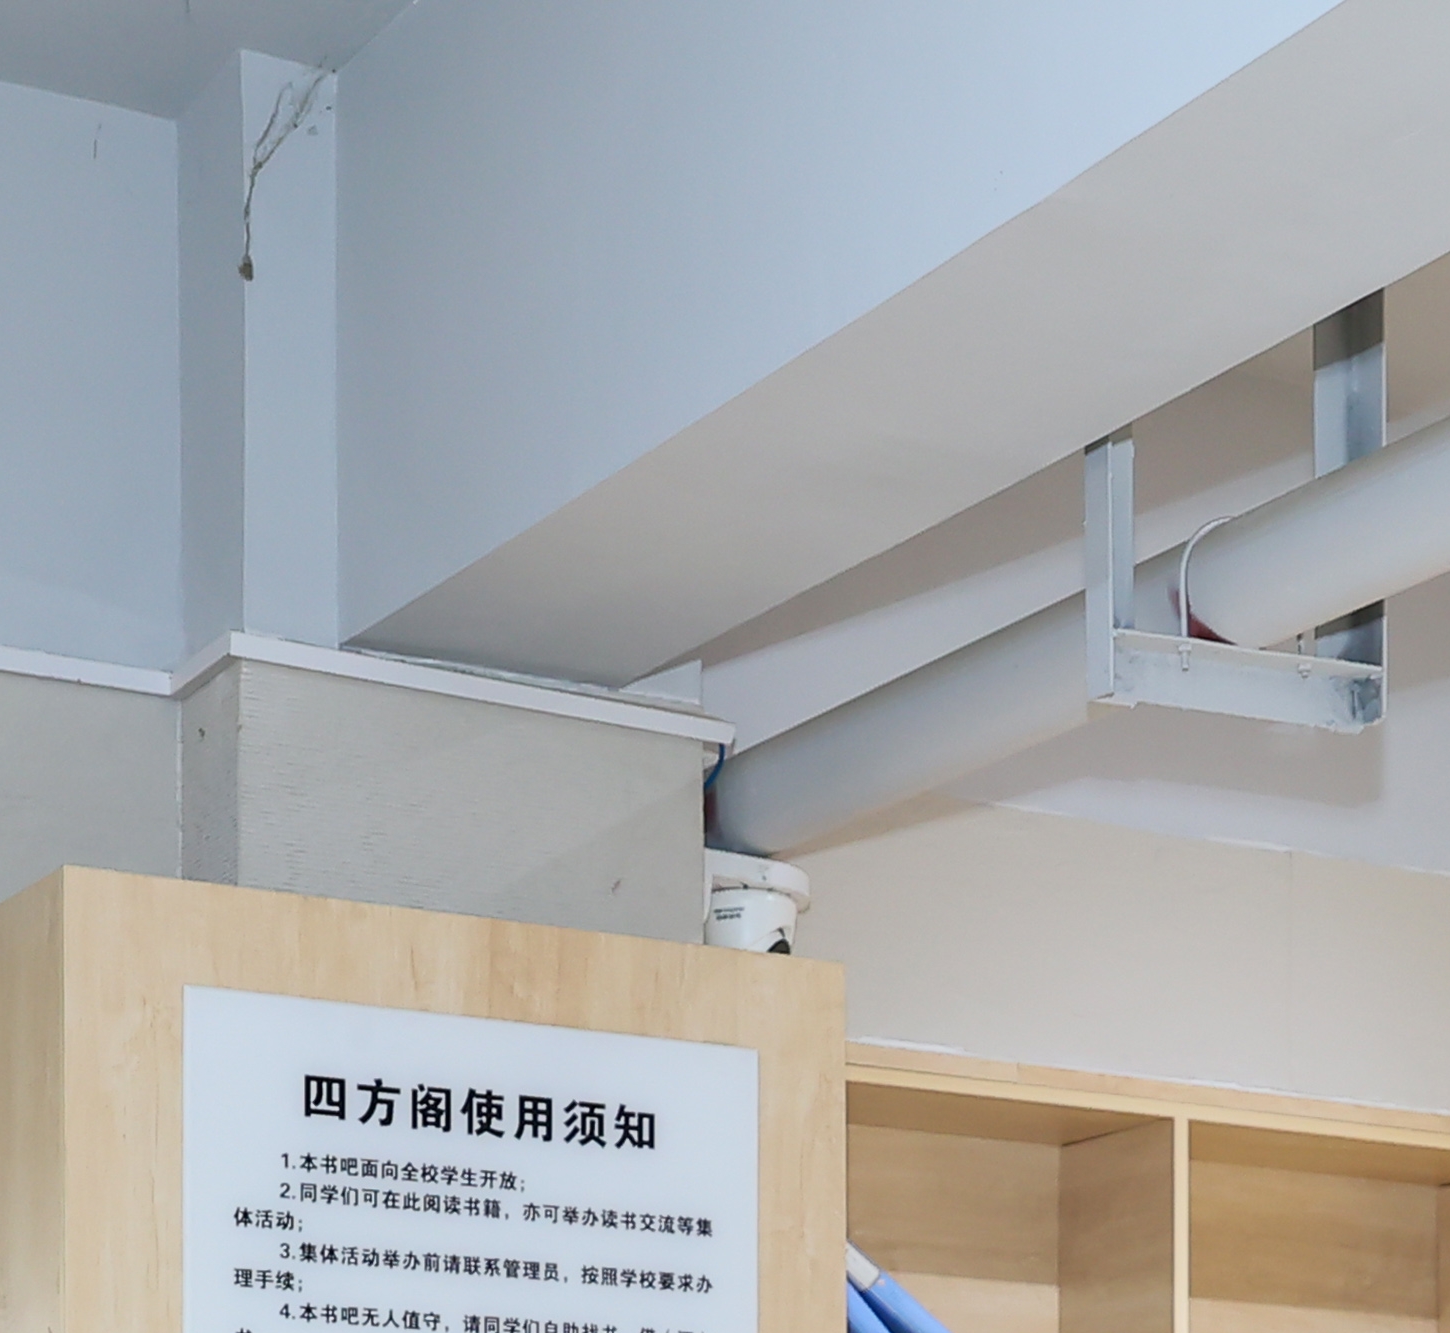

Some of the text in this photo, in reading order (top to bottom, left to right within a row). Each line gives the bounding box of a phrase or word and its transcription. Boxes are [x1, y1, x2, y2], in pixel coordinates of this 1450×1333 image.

[303, 1073, 658, 1151] 四方阁使用须知
[233, 1206, 303, 1233] 体活动；
[233, 1267, 303, 1293] 理手续；
